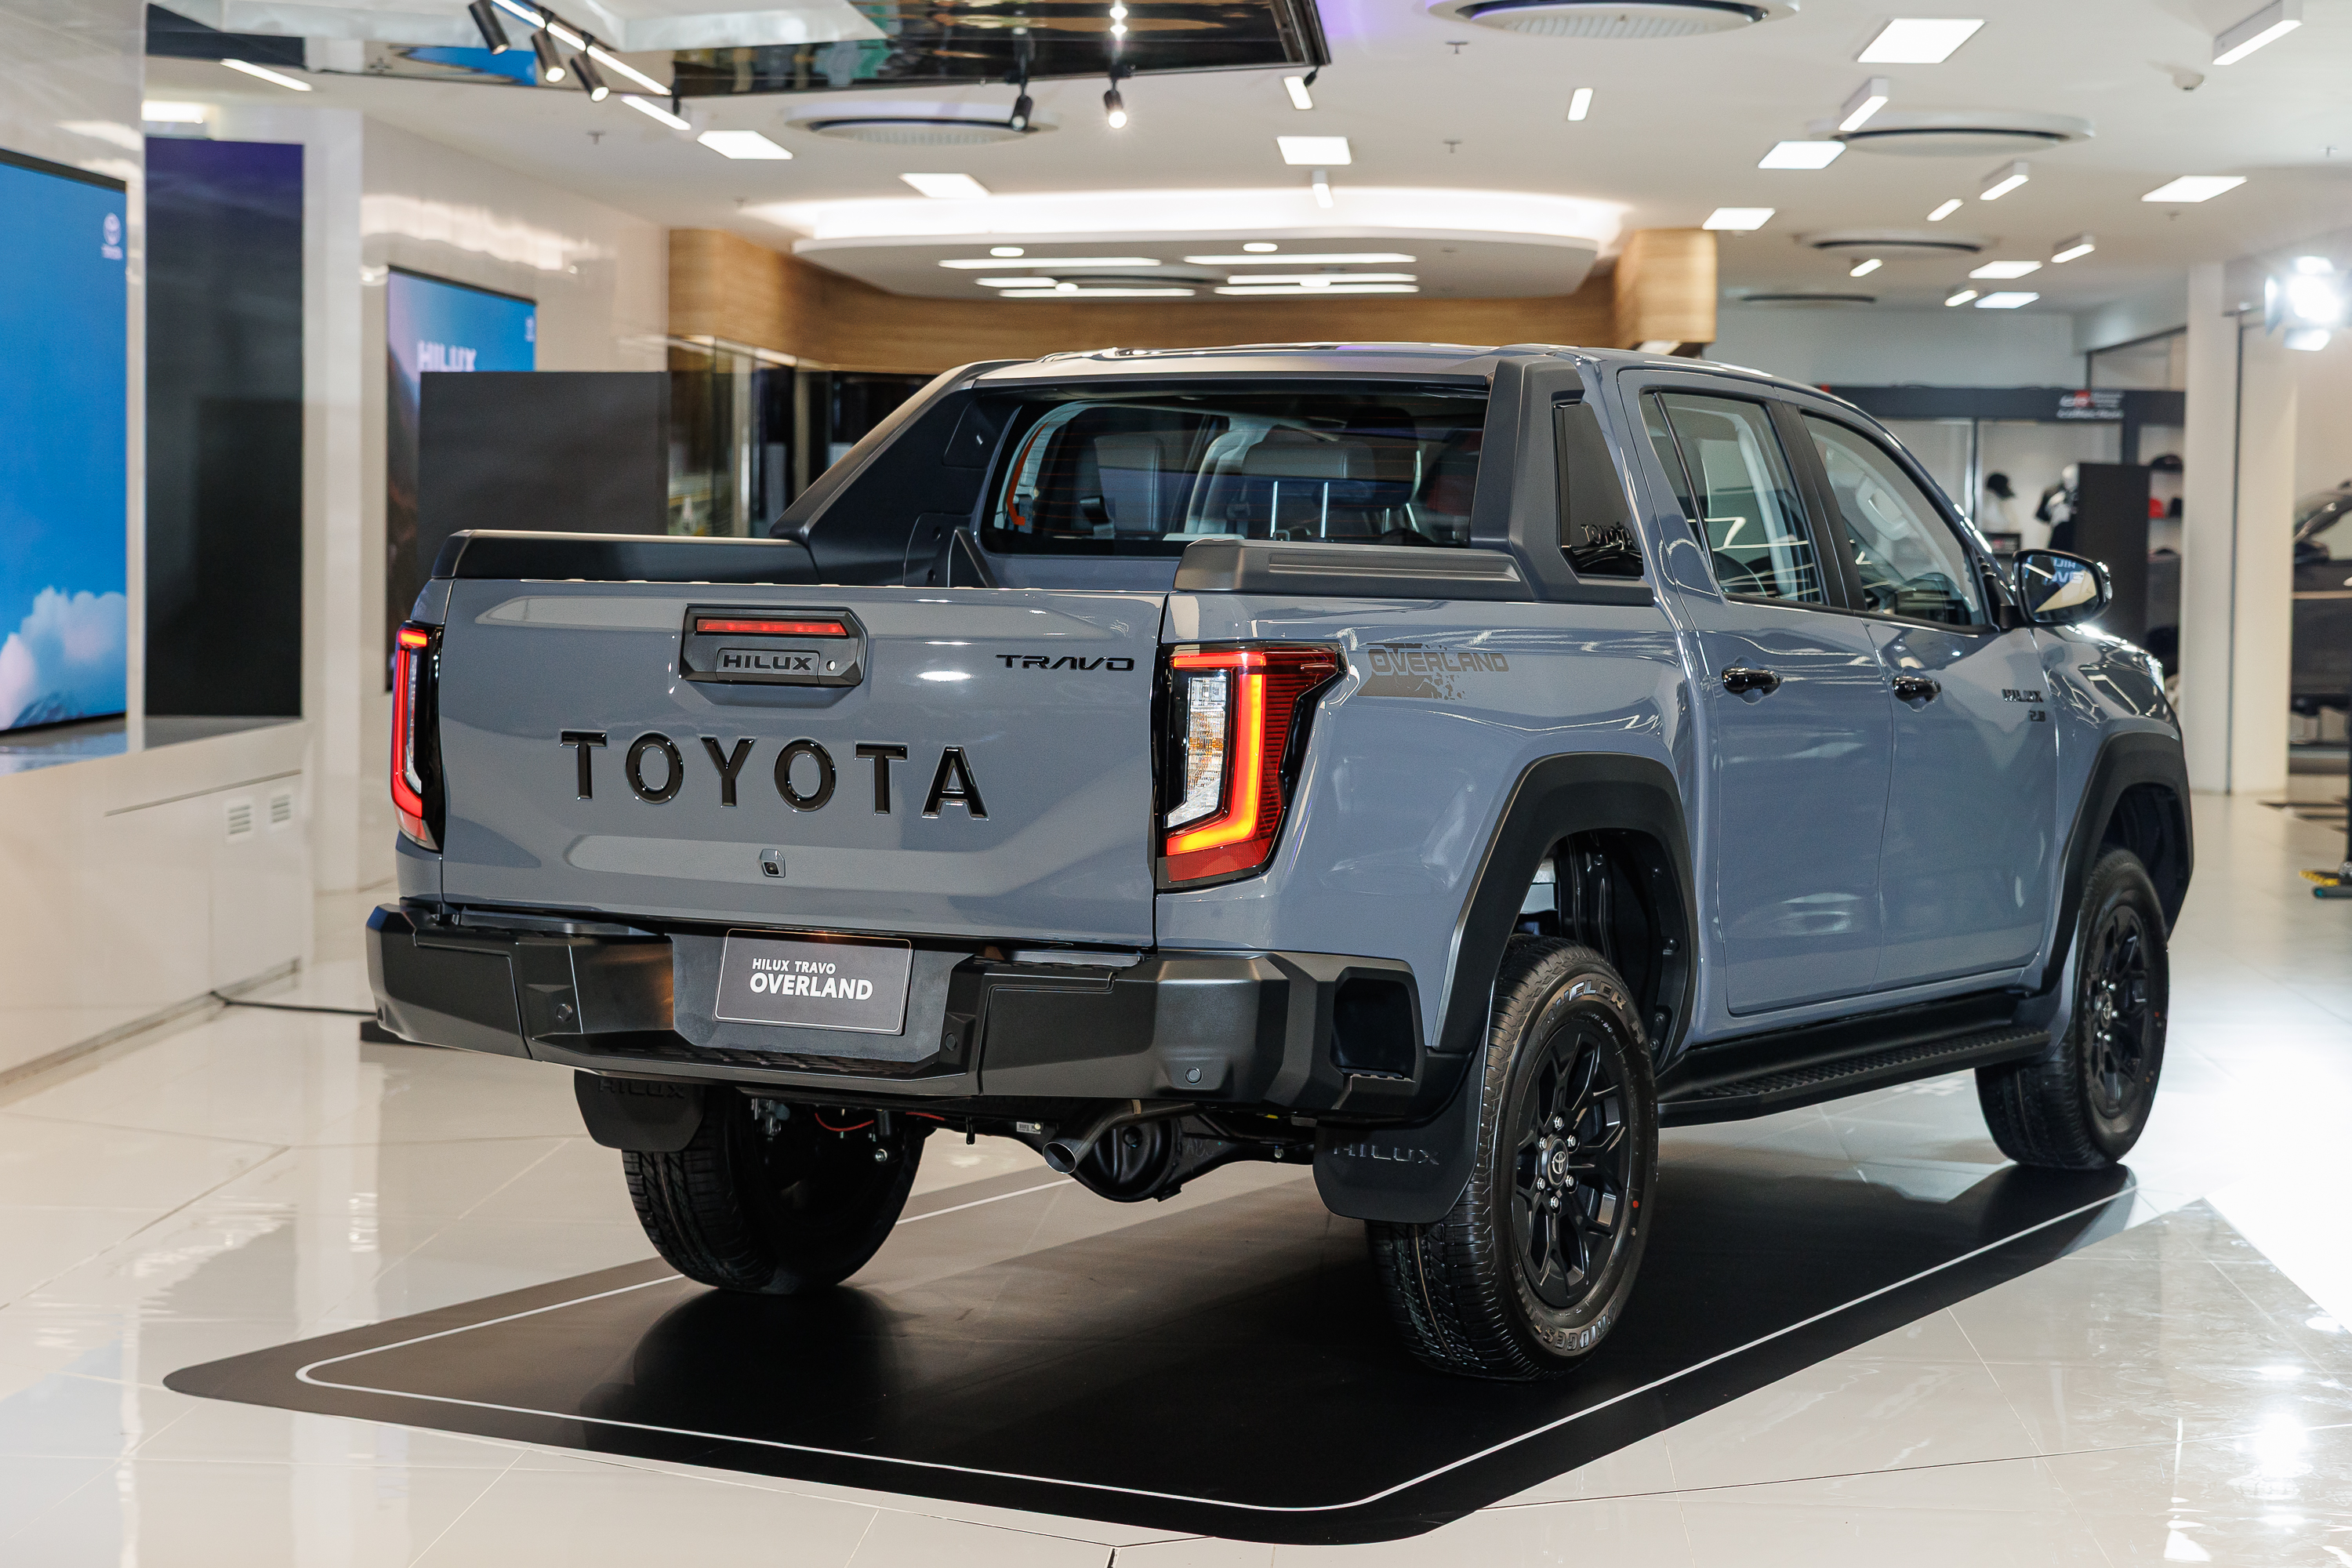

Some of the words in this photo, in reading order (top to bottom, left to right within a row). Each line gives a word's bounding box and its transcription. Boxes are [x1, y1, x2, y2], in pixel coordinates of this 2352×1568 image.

[723, 655, 812, 671] HILUX
[995, 654, 1134, 671] TRAVO
[1368, 648, 1509, 673] OVERLAND
[560, 730, 990, 821] TOYOTA
[752, 958, 789, 971] HILUX
[794, 961, 836, 975] TRAVO
[750, 972, 873, 1000] OVERLAND
[599, 1077, 685, 1098] HILUX
[1334, 1143, 1440, 1165] HILUX
